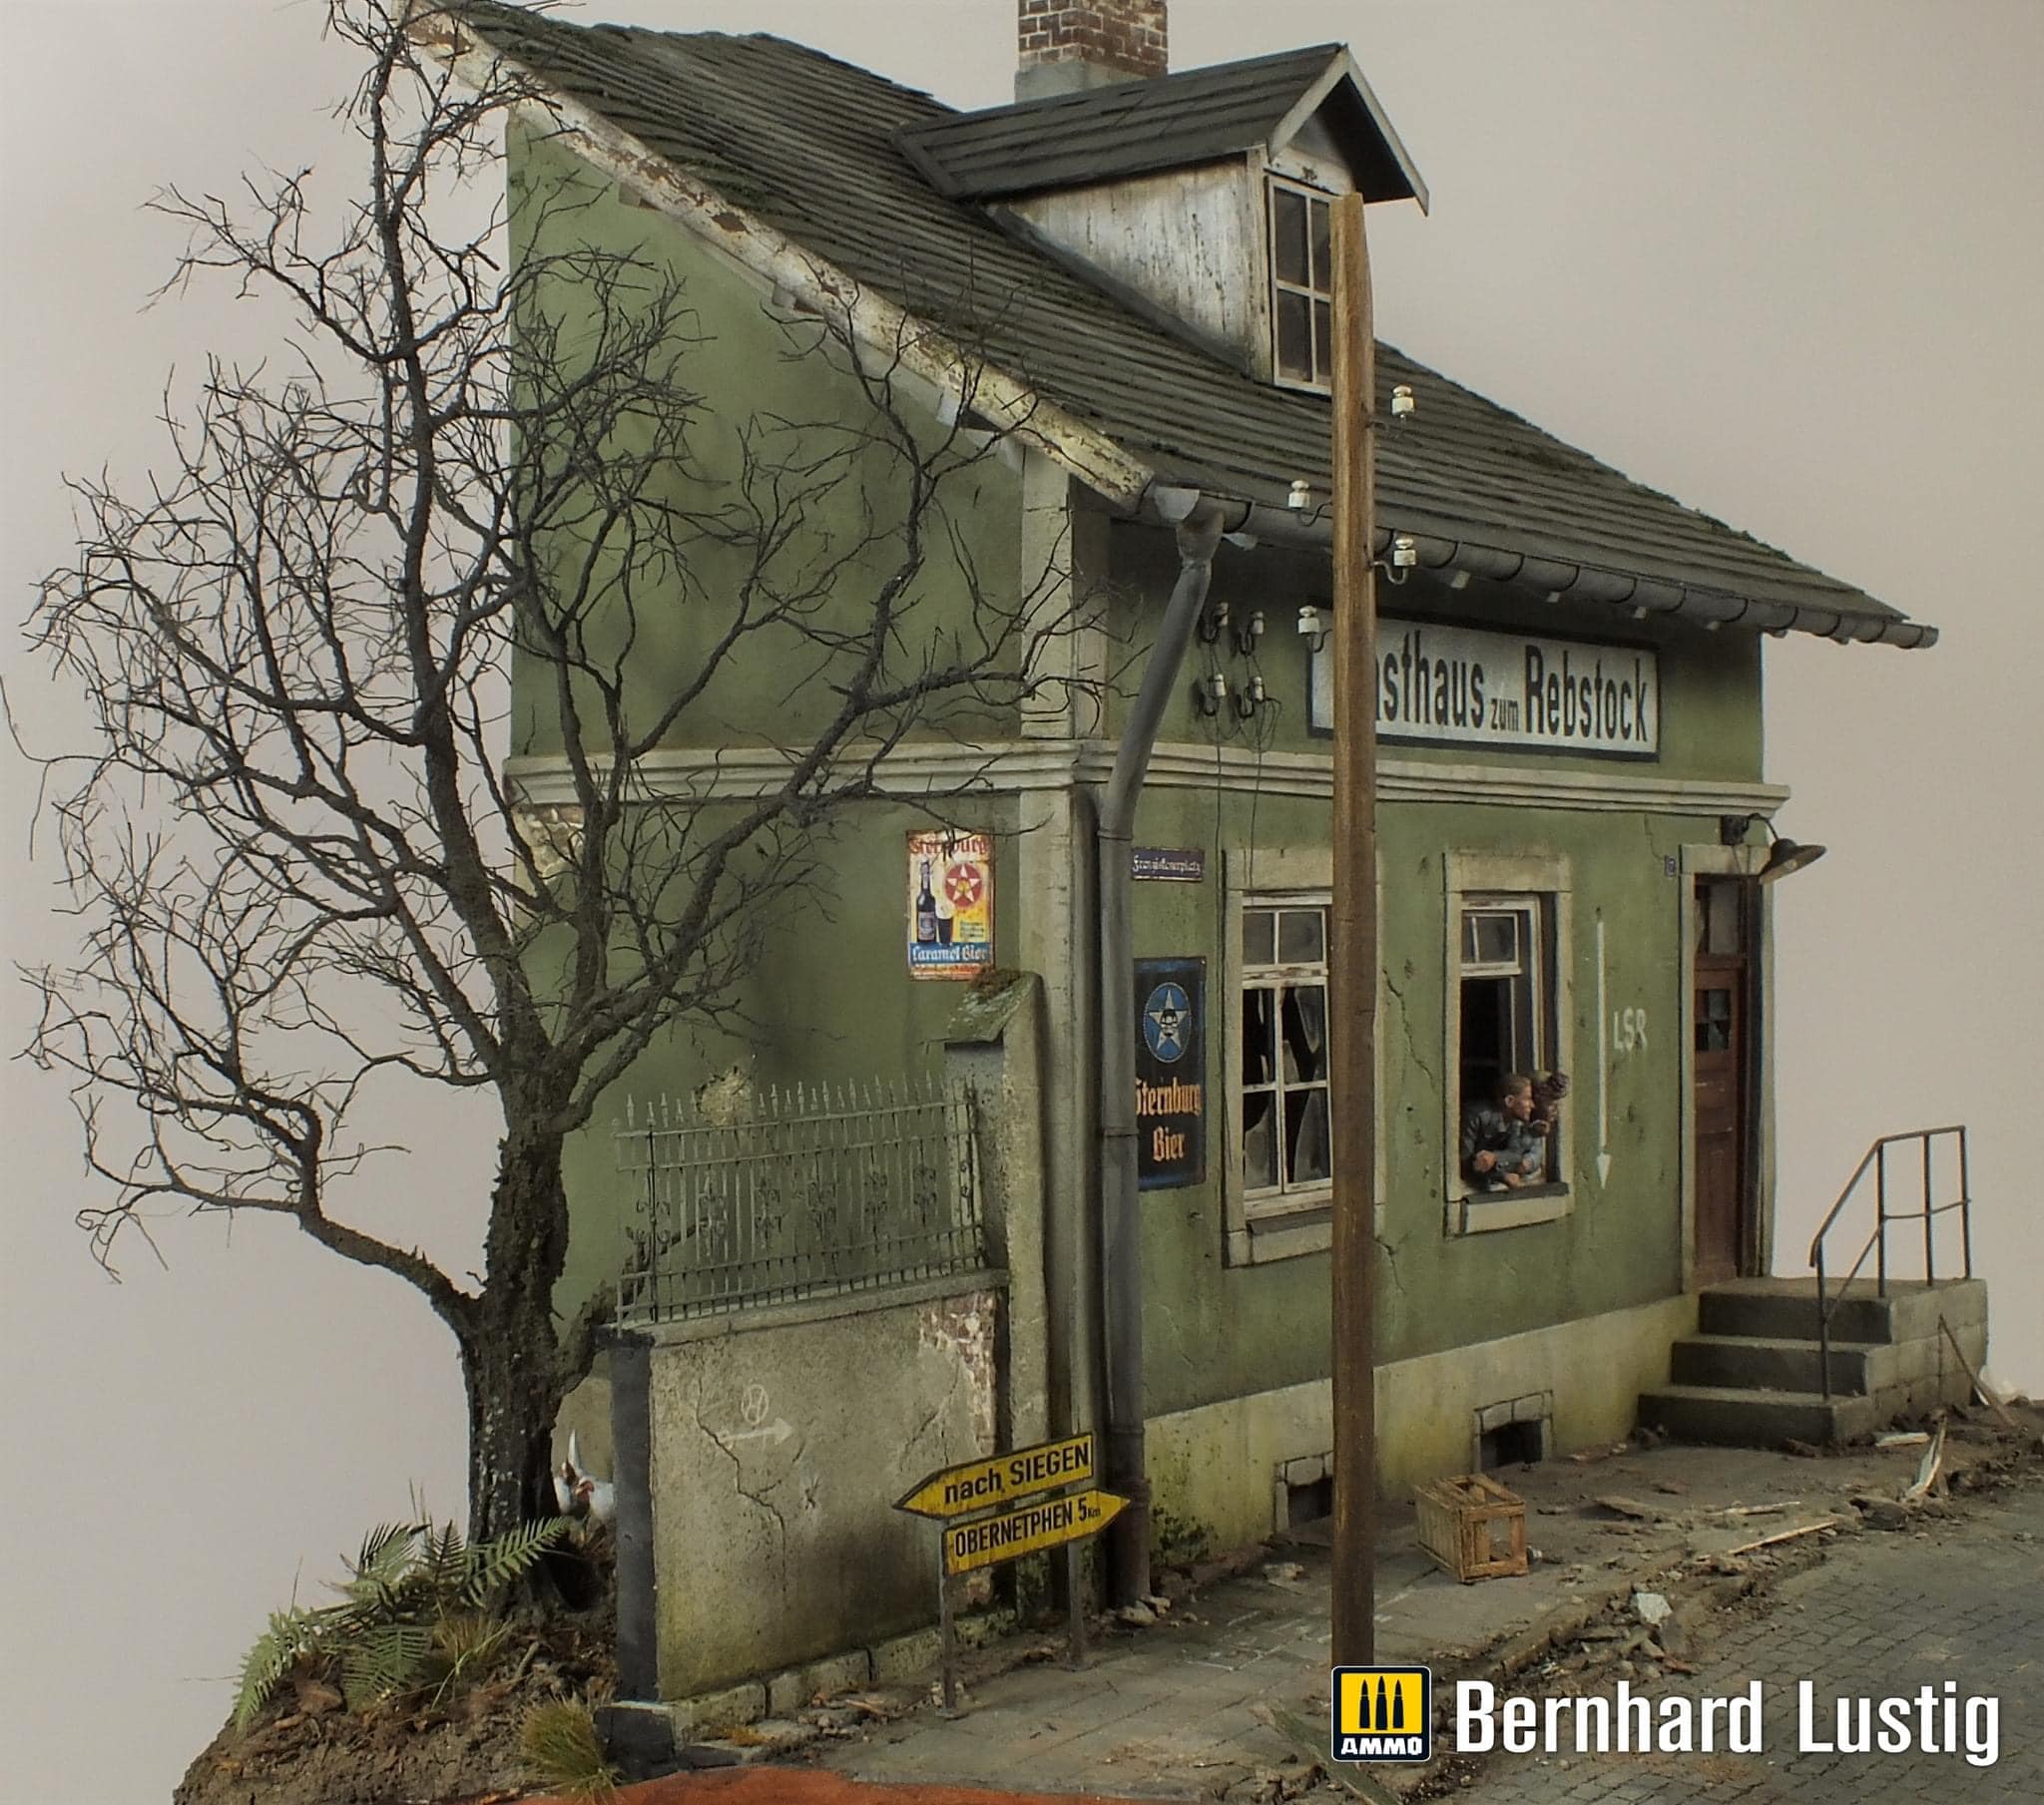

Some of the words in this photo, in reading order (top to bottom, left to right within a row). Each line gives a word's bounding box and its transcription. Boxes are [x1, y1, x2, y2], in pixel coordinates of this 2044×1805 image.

[1375, 630, 1484, 728] sthaus
[1491, 696, 1519, 731] zum
[1525, 645, 1649, 742] Rebstock
[1613, 1007, 1647, 1052] LSR
[1153, 1126, 1186, 1162] Bier
[944, 1469, 1002, 1504] nach
[1010, 1443, 1089, 1486] SIEGEN
[954, 1500, 1074, 1558] OBERNETPHEN
